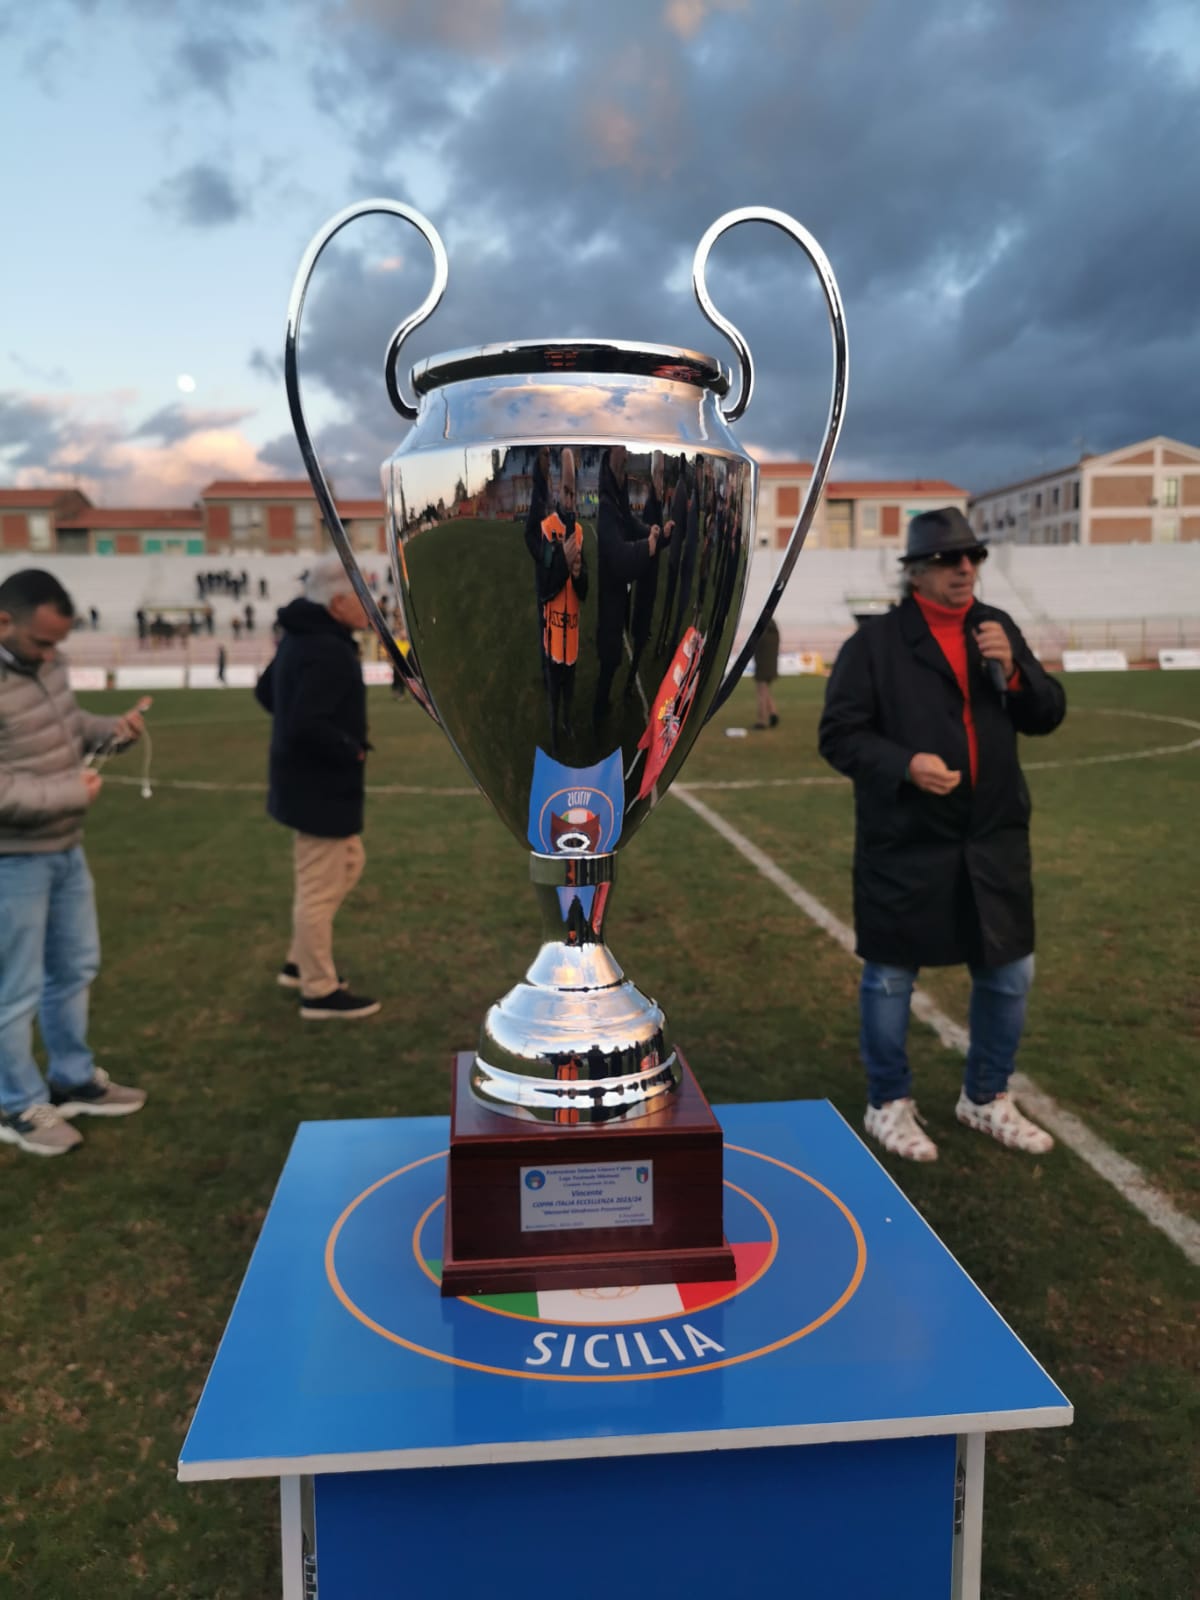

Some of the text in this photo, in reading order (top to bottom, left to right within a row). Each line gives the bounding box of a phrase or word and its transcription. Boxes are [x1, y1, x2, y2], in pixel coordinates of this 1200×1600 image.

[571, 1189, 603, 1197] Vincente
[555, 1199, 575, 1207] ITALIA
[525, 1323, 726, 1368] SICILIA
